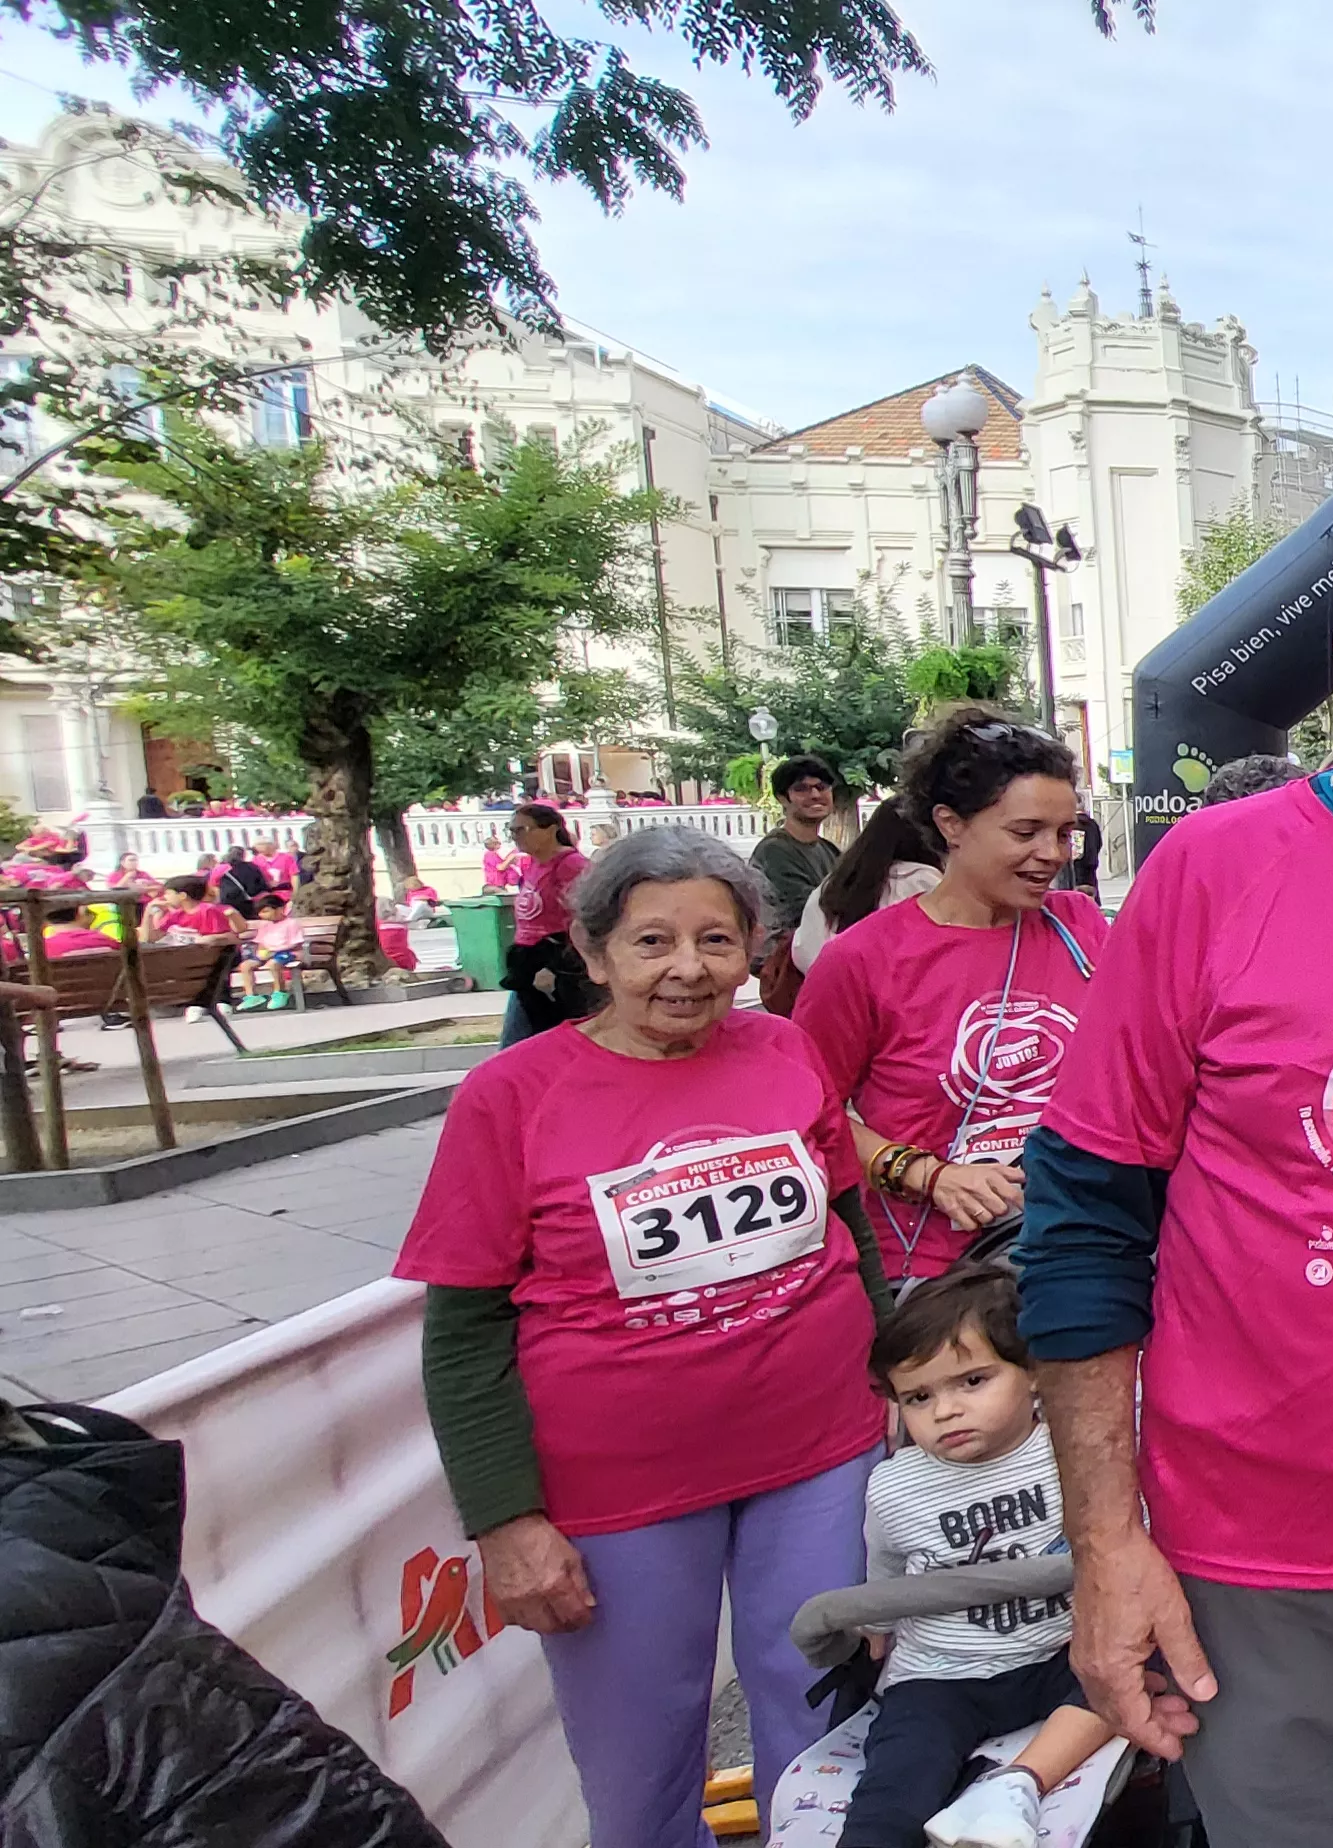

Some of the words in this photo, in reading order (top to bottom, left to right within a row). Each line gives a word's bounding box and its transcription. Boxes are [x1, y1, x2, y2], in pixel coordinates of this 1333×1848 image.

[1191, 659, 1237, 695] Pisa
[1230, 627, 1282, 663] bien,
[1275, 594, 1313, 626] vive
[625, 1175, 708, 1206] CONTRA
[708, 1169, 730, 1185] EL
[736, 1155, 793, 1180] CÁNCER
[687, 1155, 742, 1176] HUESCA
[630, 1175, 808, 1261] 3129
[938, 1483, 1047, 1550] BORN
